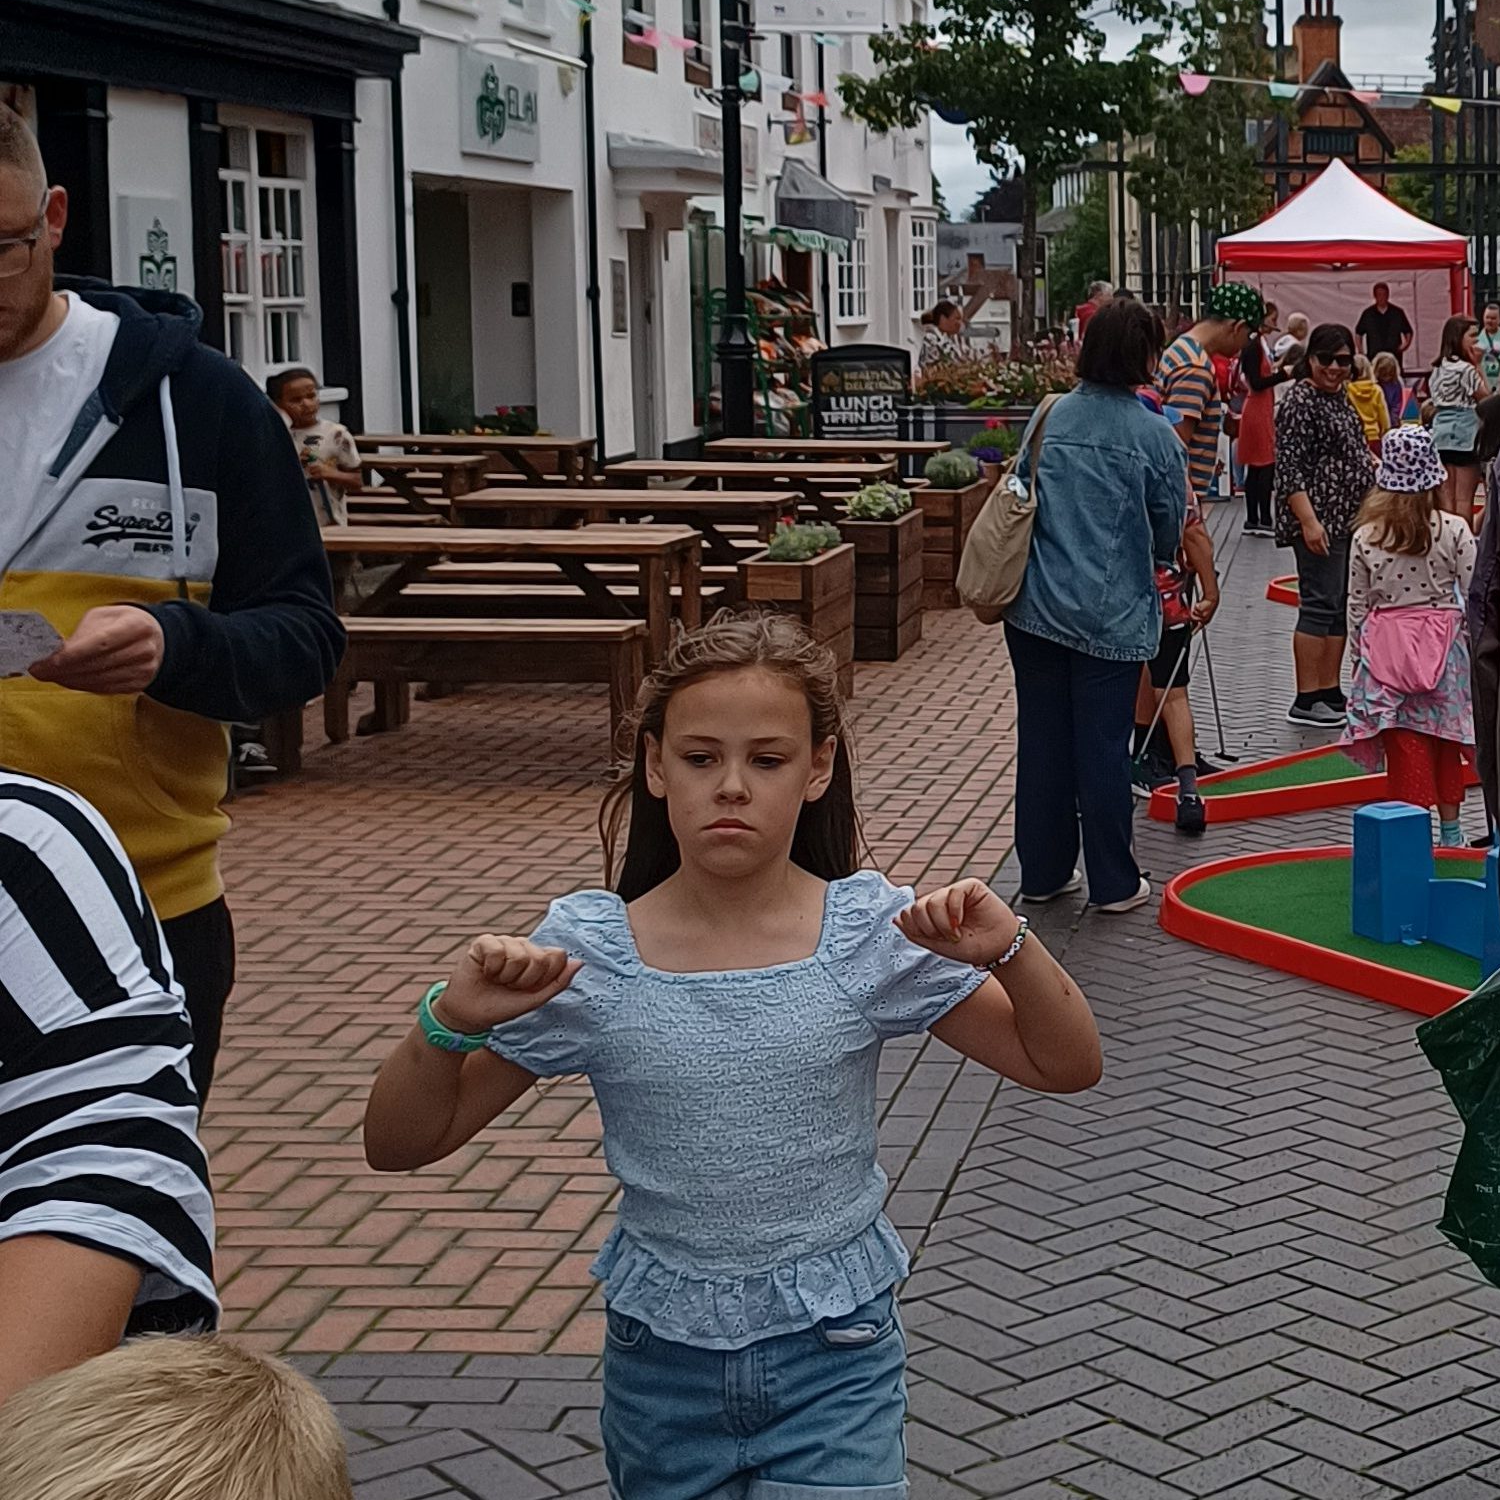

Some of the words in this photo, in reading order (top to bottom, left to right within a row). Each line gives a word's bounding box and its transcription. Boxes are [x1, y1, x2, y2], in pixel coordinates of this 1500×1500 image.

[830, 395, 893, 411] LUNCH
[821, 411, 867, 424] TIFFIN
[1475, 1184, 1493, 1194] This
